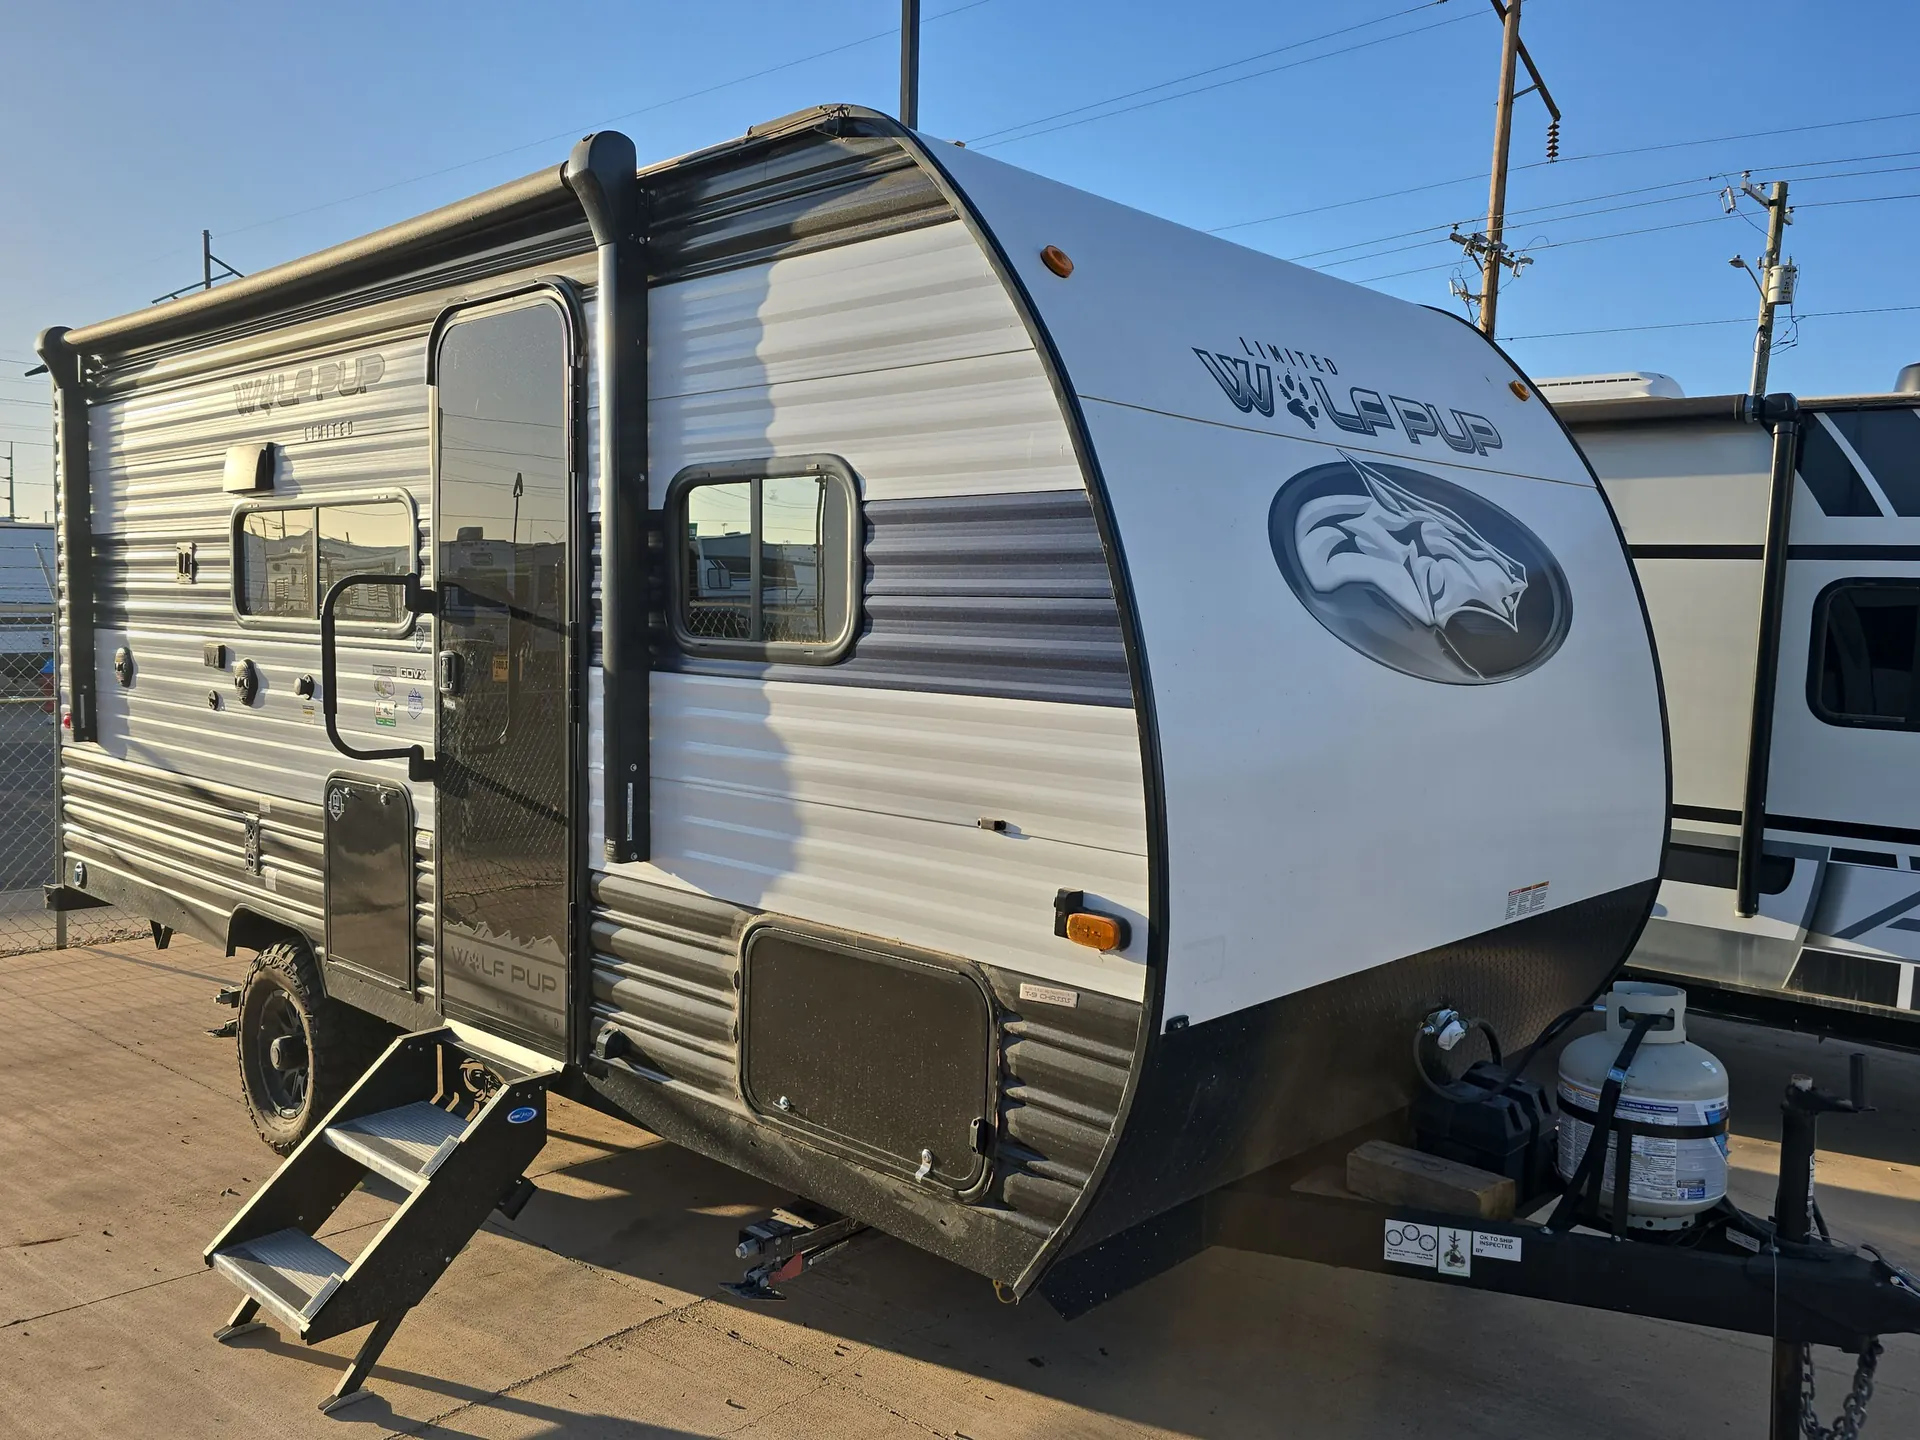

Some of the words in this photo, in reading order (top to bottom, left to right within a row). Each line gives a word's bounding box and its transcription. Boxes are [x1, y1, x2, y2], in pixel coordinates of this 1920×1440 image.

[1238, 336, 1339, 376] LIMITED
[316, 353, 386, 401] PUP
[304, 420, 354, 442] LIMITED
[1388, 394, 1504, 457] PUP
[400, 667, 427, 681] GOVX
[510, 964, 557, 993] PUP
[1479, 1240, 1514, 1250] INSPECTED
